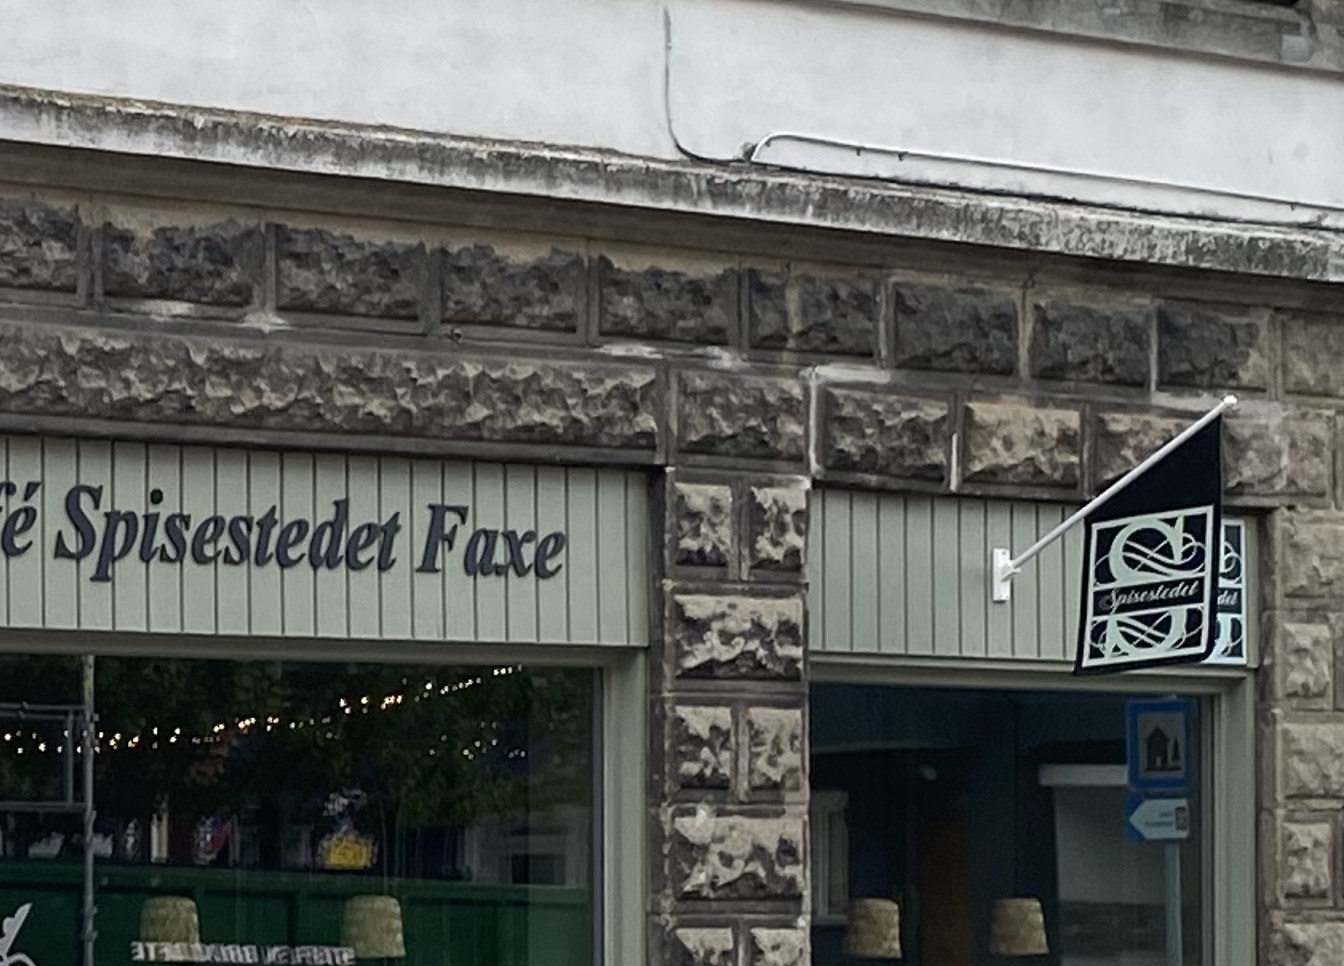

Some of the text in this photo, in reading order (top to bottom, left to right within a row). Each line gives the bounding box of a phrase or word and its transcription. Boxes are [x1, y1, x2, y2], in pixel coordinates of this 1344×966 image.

[54, 484, 401, 583] Spisestedet
[415, 502, 566, 580] Faxe
[1098, 579, 1200, 615] Spisestedet
